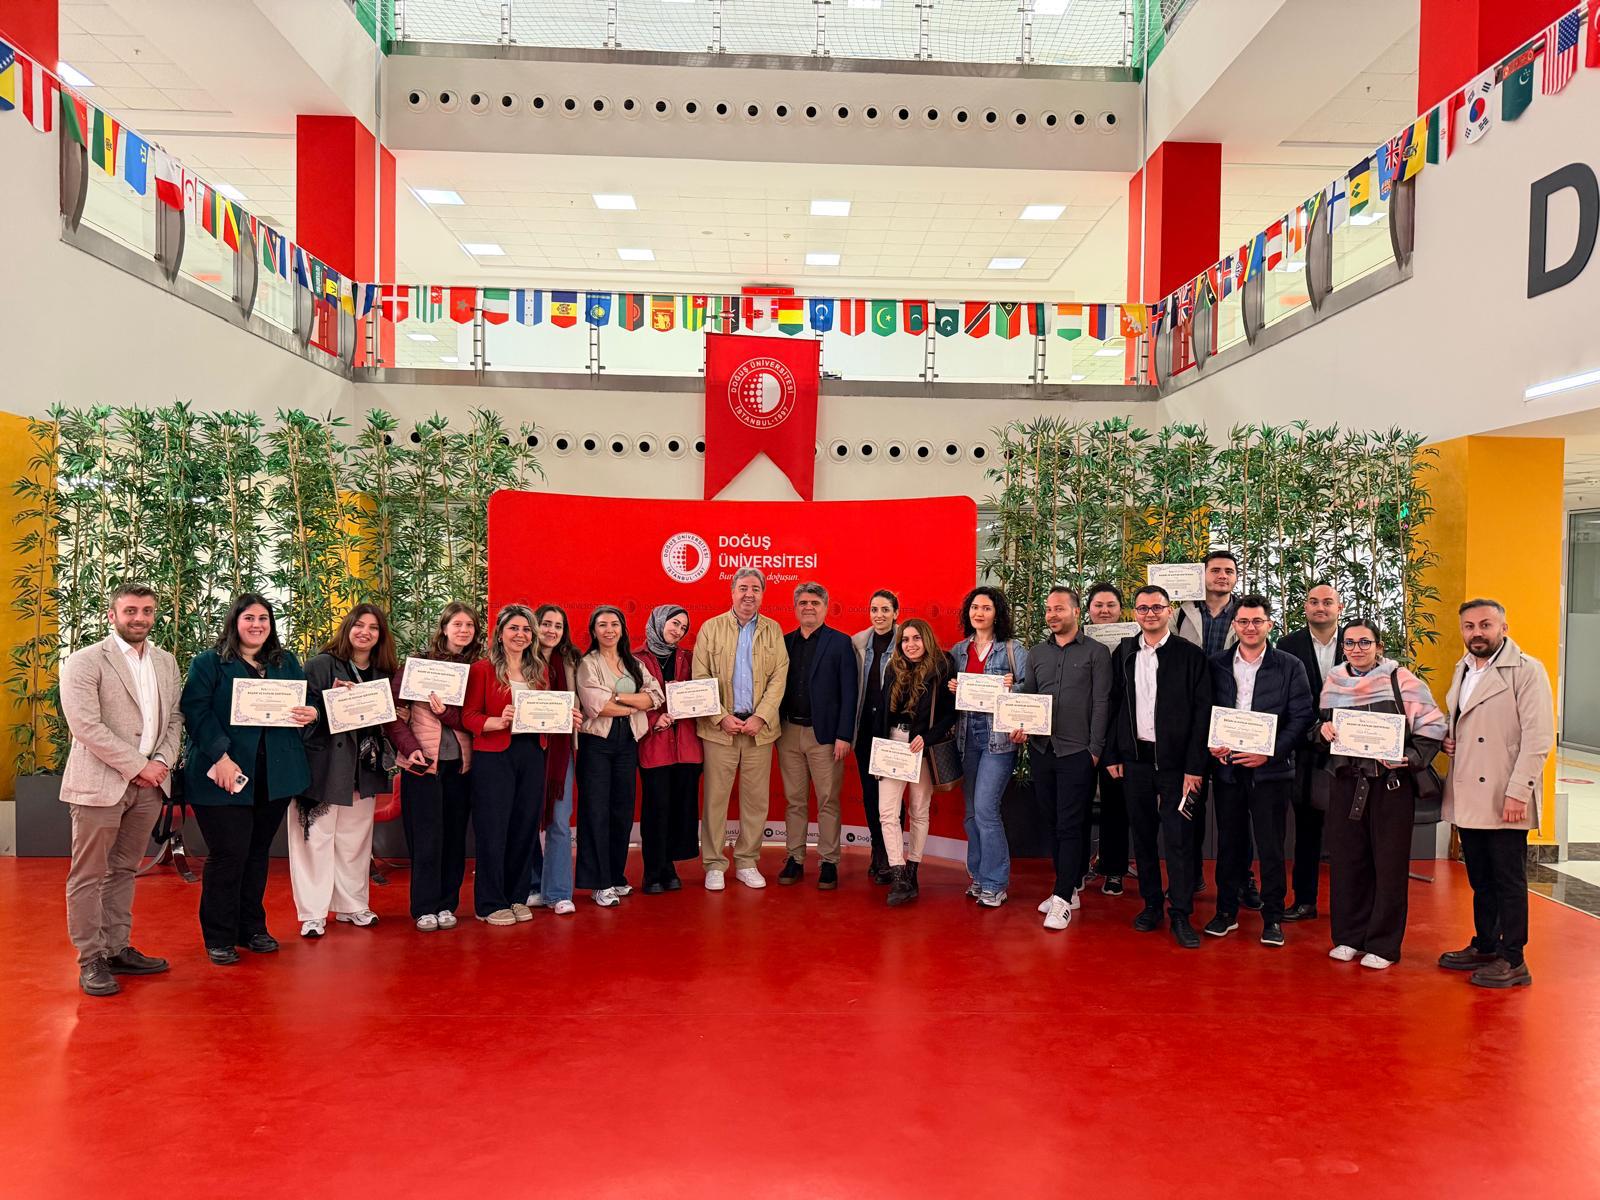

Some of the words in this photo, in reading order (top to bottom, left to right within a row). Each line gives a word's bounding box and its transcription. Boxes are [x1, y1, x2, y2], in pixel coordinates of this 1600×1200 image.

[1527, 162, 1600, 299] D
[730, 366, 749, 393] DOĞUŞ
[749, 359, 794, 394] ÜNİVERSİTESİ
[718, 533, 772, 551] DOĞUŞ
[718, 552, 818, 569] ÜNİVERSİTESİ
